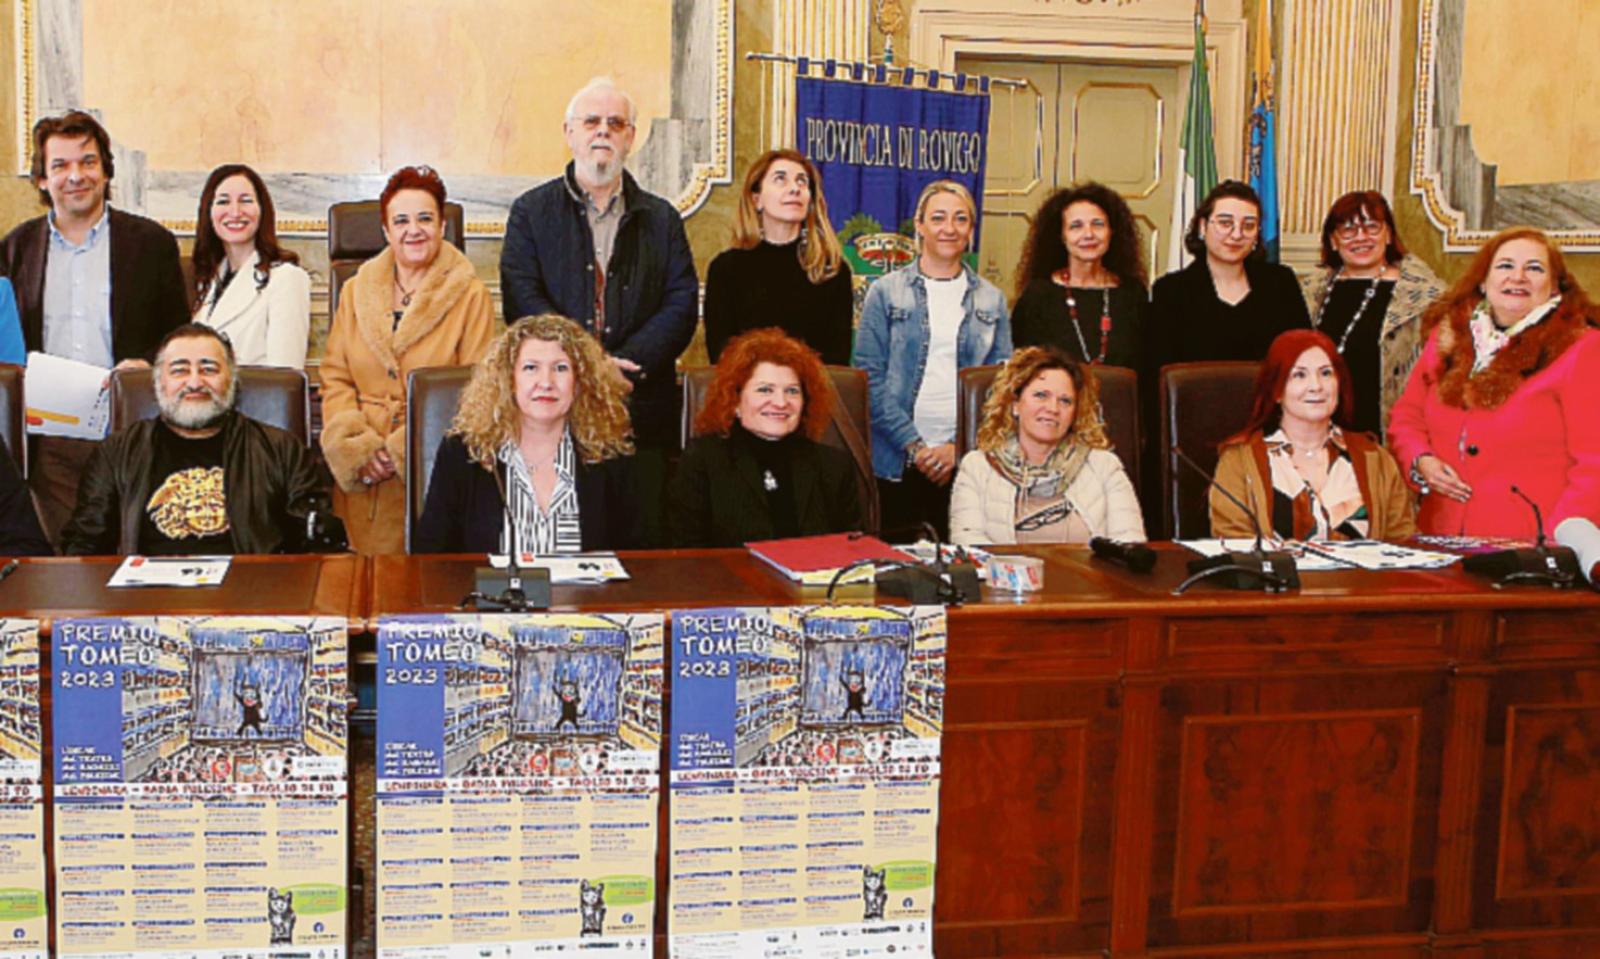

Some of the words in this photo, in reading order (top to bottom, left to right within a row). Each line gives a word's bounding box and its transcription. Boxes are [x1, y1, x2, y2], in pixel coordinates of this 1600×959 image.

[806, 117, 895, 166] PROVINCIA
[898, 126, 914, 169] DI
[918, 128, 981, 173] ROVIGO
[62, 624, 154, 641] PREMIO
[680, 615, 767, 634] PREMIO
[386, 642, 475, 662] TOMEO
[680, 636, 767, 655] TOMEO
[60, 645, 153, 665] TOMEO
[386, 668, 437, 684] 2023
[680, 660, 730, 677] 2023
[61, 671, 115, 688] 2023
[853, 765, 894, 775] TAGLIO
[252, 783, 297, 793] TAGLIO
[569, 777, 611, 786] TAGLIO
